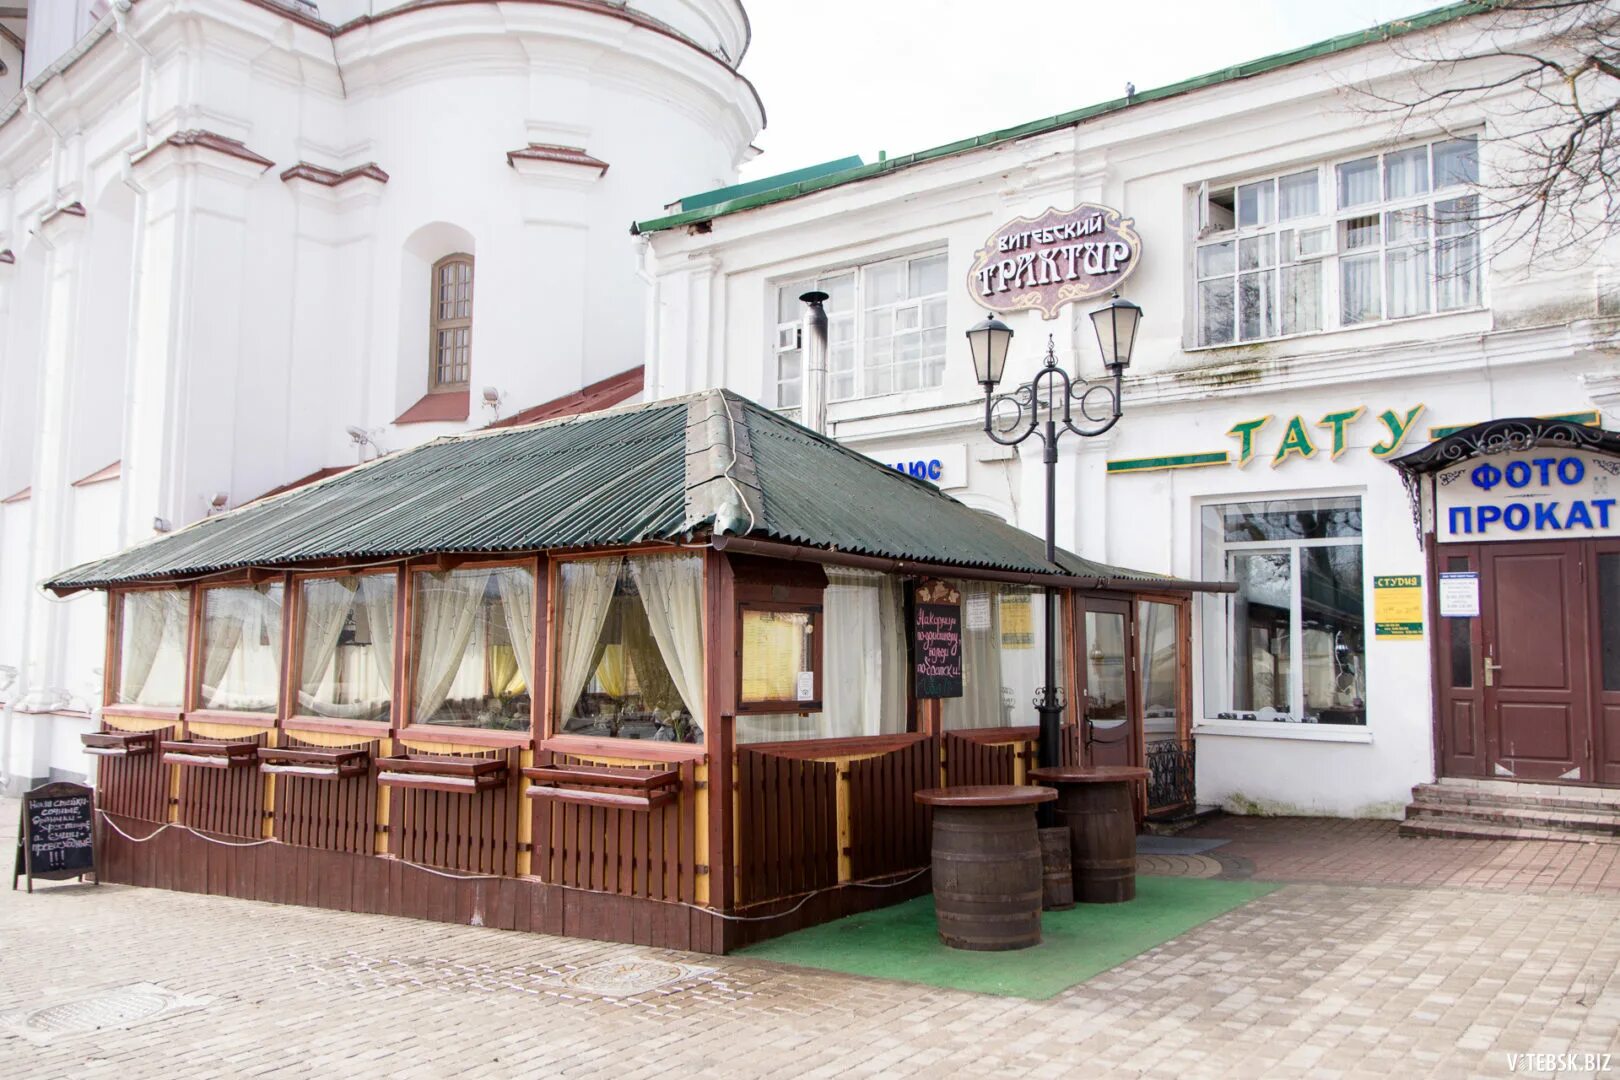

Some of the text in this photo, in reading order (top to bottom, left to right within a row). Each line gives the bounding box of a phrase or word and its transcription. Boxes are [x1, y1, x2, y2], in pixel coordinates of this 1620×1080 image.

[999, 213, 1103, 251] ВИТЕБСКИЙ
[978, 242, 1130, 296] ТРАКТИР
[1226, 403, 1425, 469] ТАТУ
[885, 459, 942, 480] ЮС
[1471, 457, 1585, 491] ФОТО
[1449, 499, 1616, 535] ПРОКАТ
[1377, 577, 1417, 587] СТУДИЯ
